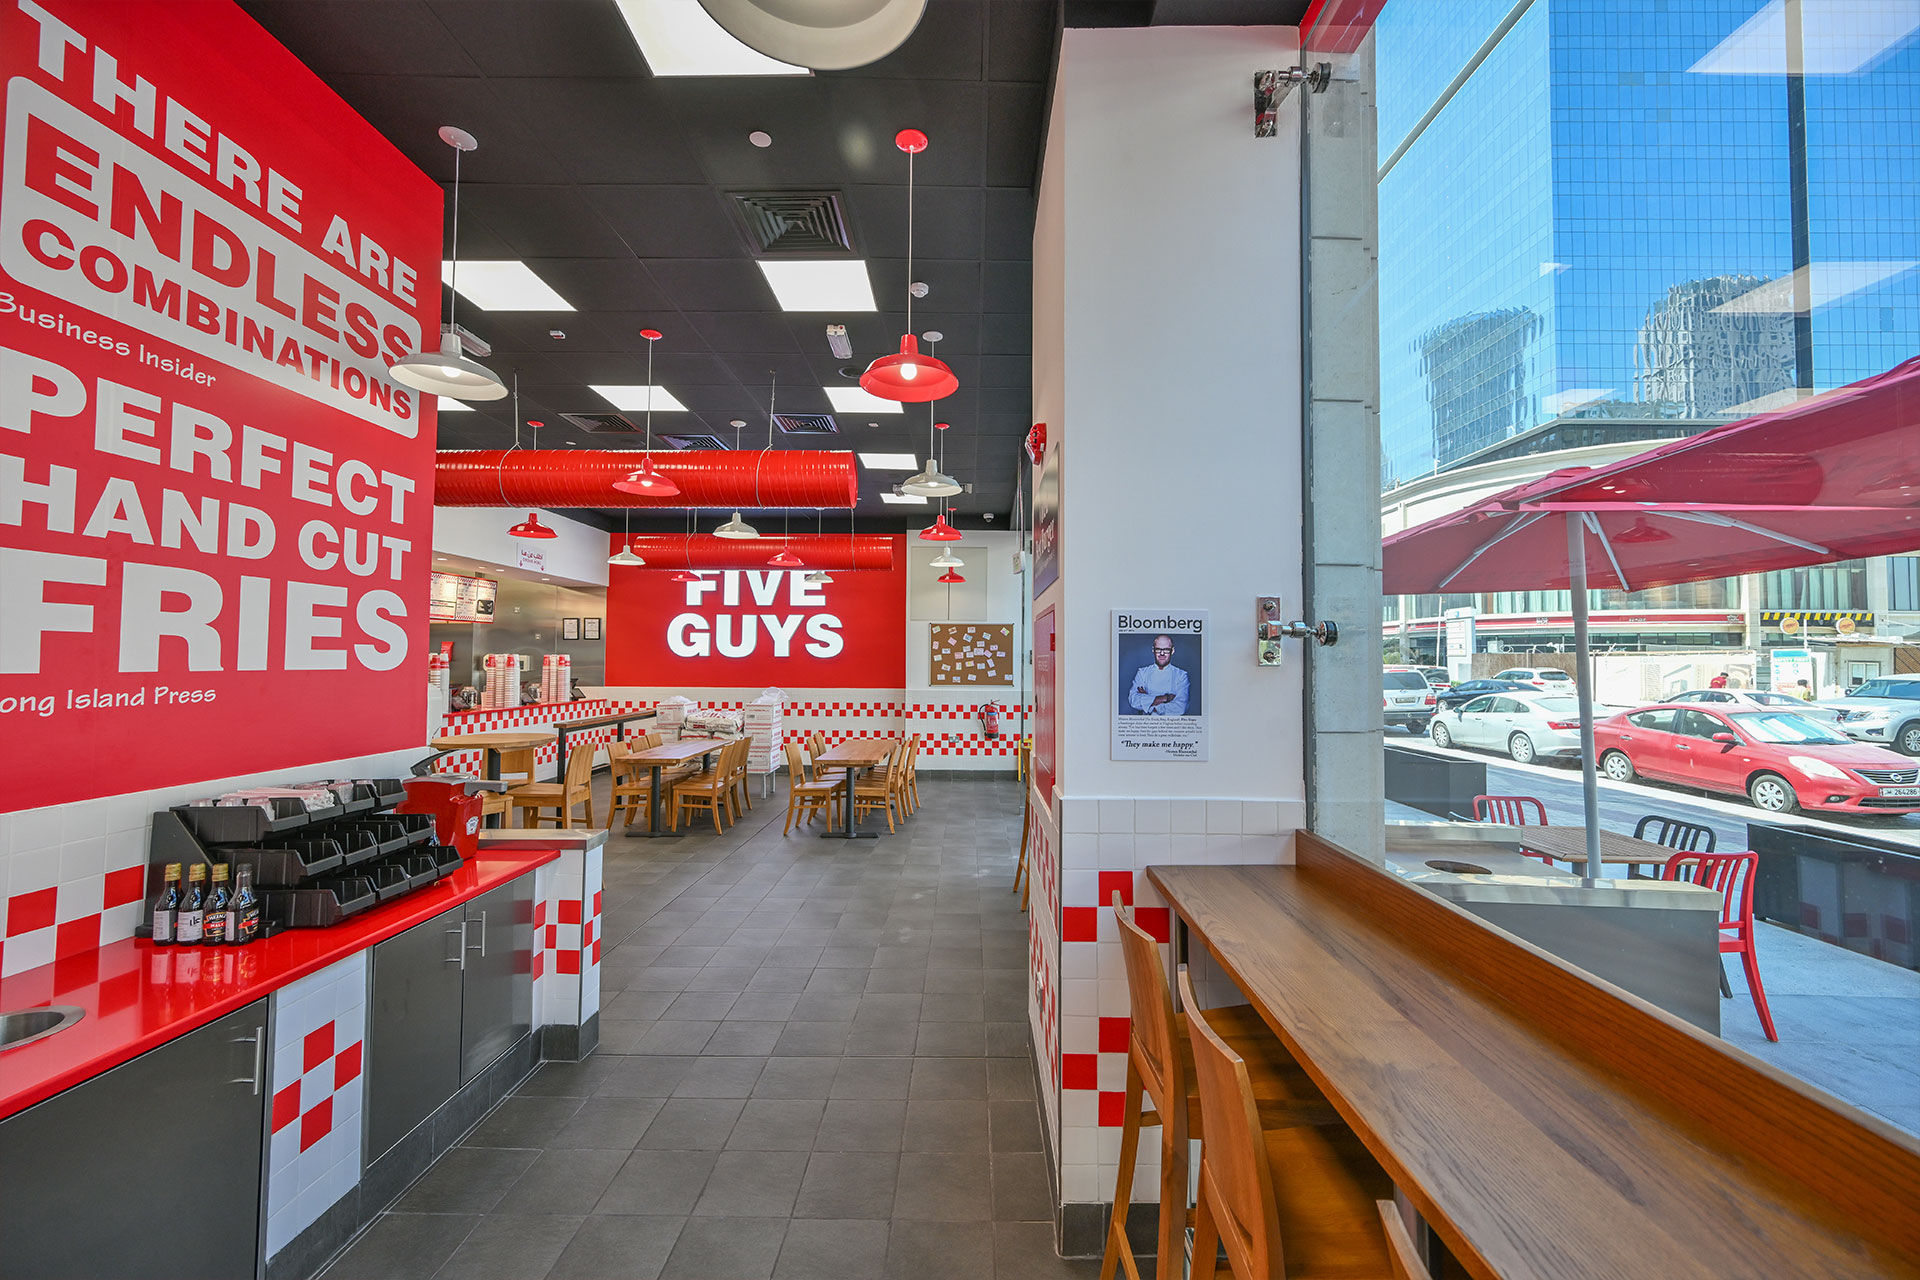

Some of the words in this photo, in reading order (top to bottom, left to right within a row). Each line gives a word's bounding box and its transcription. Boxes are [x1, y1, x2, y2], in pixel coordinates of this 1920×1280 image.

[18, 0, 303, 234] THERE
[320, 214, 418, 309] ARE
[24, 112, 413, 365] ENDLESS
[0, 292, 131, 357] Business
[138, 343, 217, 388] Insider
[21, 218, 412, 420] COMBINATIONS
[0, 345, 416, 525] PERFECT
[0, 453, 277, 560] HAND
[297, 519, 412, 581] CUT
[0, 546, 409, 675] FRIES
[666, 612, 845, 659] GUYS
[686, 570, 827, 607] FIVE
[1118, 615, 1203, 633] Bloomberg
[0, 690, 55, 717] ong
[66, 686, 145, 710] Island
[153, 685, 217, 705] Press
[1141, 740, 1160, 748] make
